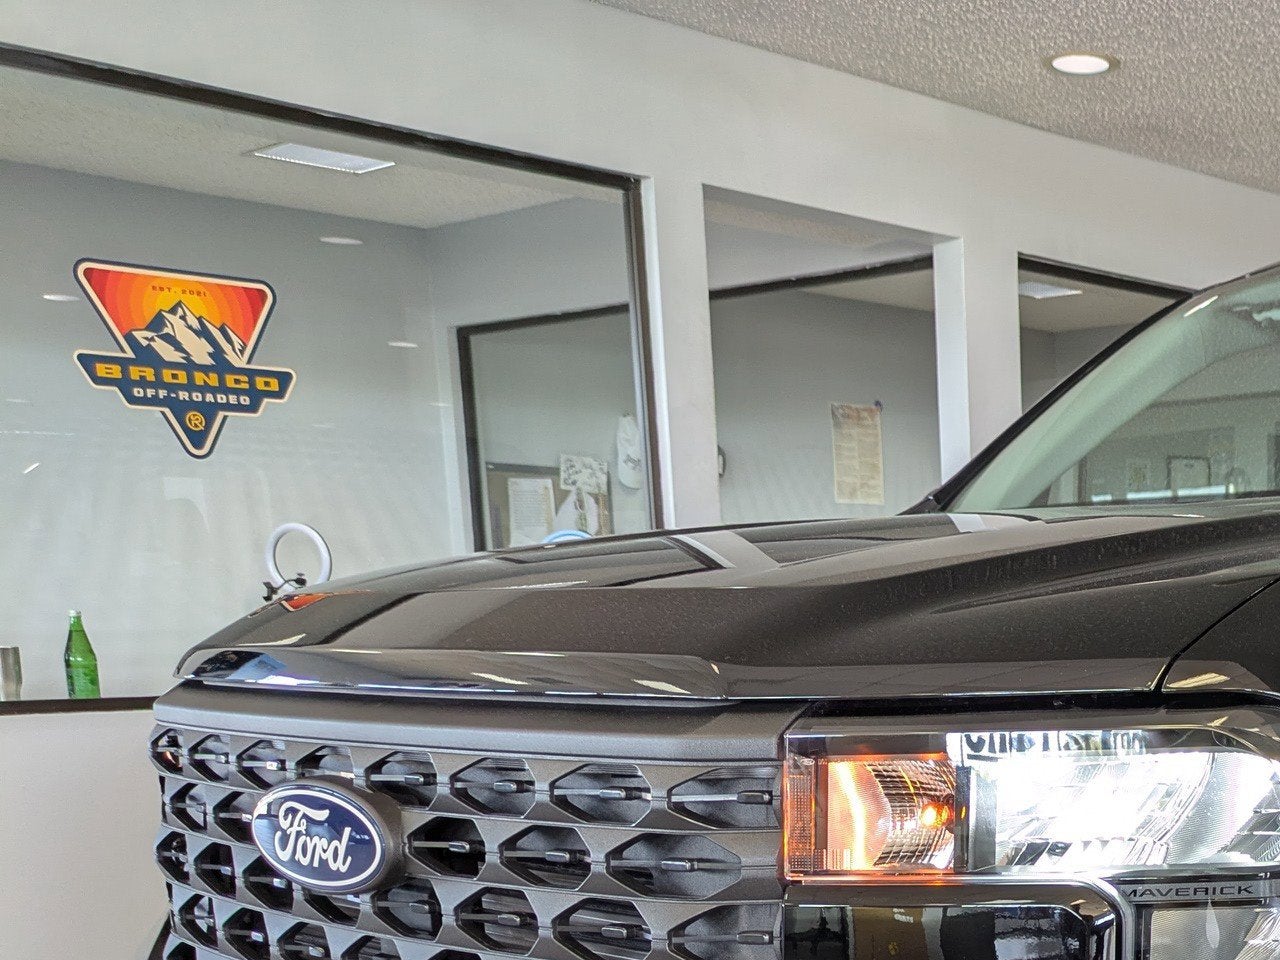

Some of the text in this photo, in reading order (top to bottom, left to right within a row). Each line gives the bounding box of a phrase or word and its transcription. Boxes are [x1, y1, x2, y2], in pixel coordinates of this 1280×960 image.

[181, 288, 207, 297] 2021
[94, 362, 280, 392] BRONCO
[132, 387, 251, 405] OFF-ROADEO
[274, 800, 352, 874] Ford
[1121, 884, 1255, 899] MAVERICK
